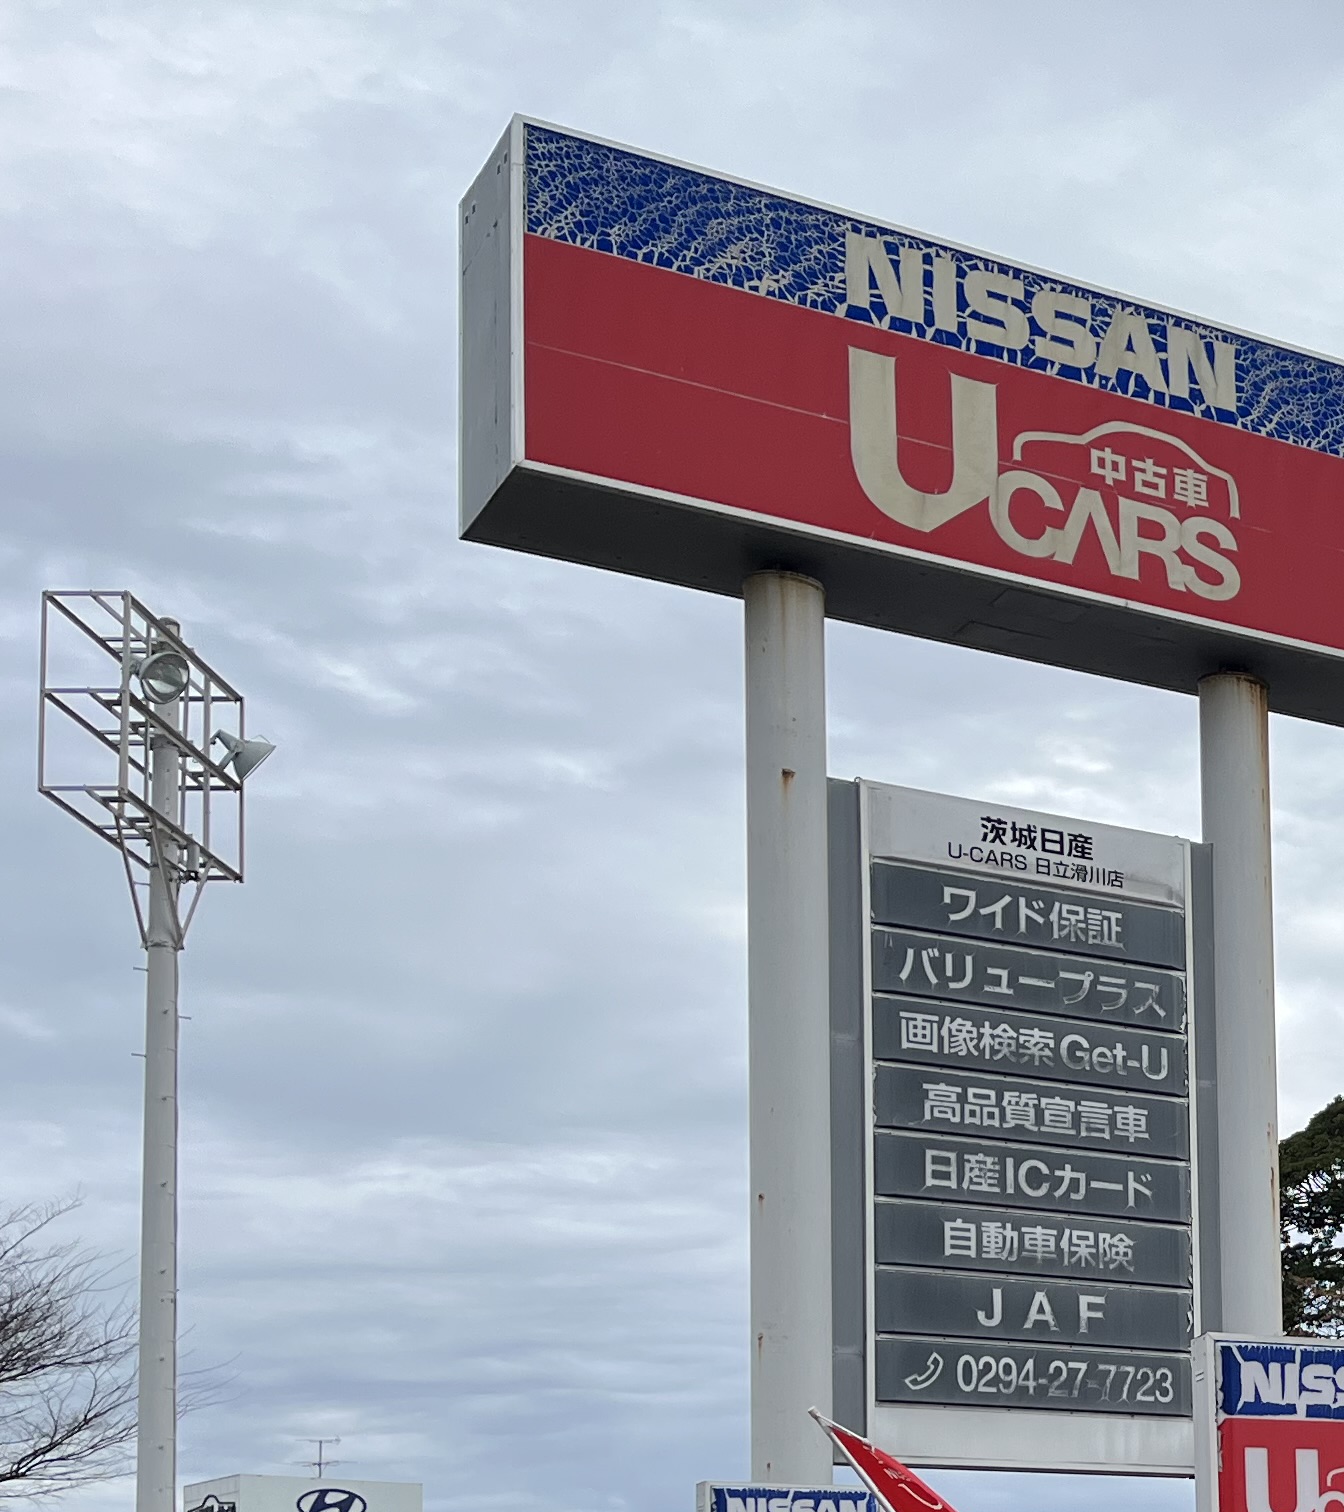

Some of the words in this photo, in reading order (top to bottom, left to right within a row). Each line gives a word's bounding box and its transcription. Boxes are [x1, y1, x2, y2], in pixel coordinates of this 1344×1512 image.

[845, 231, 1236, 410] NISSAN
[1090, 447, 1209, 509] 中古車
[948, 841, 1028, 871] U-CARS
[1035, 857, 1125, 889] 日立滑川店
[980, 815, 1094, 861] 茨城日産
[942, 884, 1125, 952] ワイド保証
[899, 945, 1166, 1019] バリュープラス
[923, 1081, 1149, 1143] 高品質宣言車
[925, 1148, 1153, 1210] 日産ICカード
[943, 1218, 1135, 1273] 自動車保険
[957, 1353, 1174, 1404] 0294-27-7723
